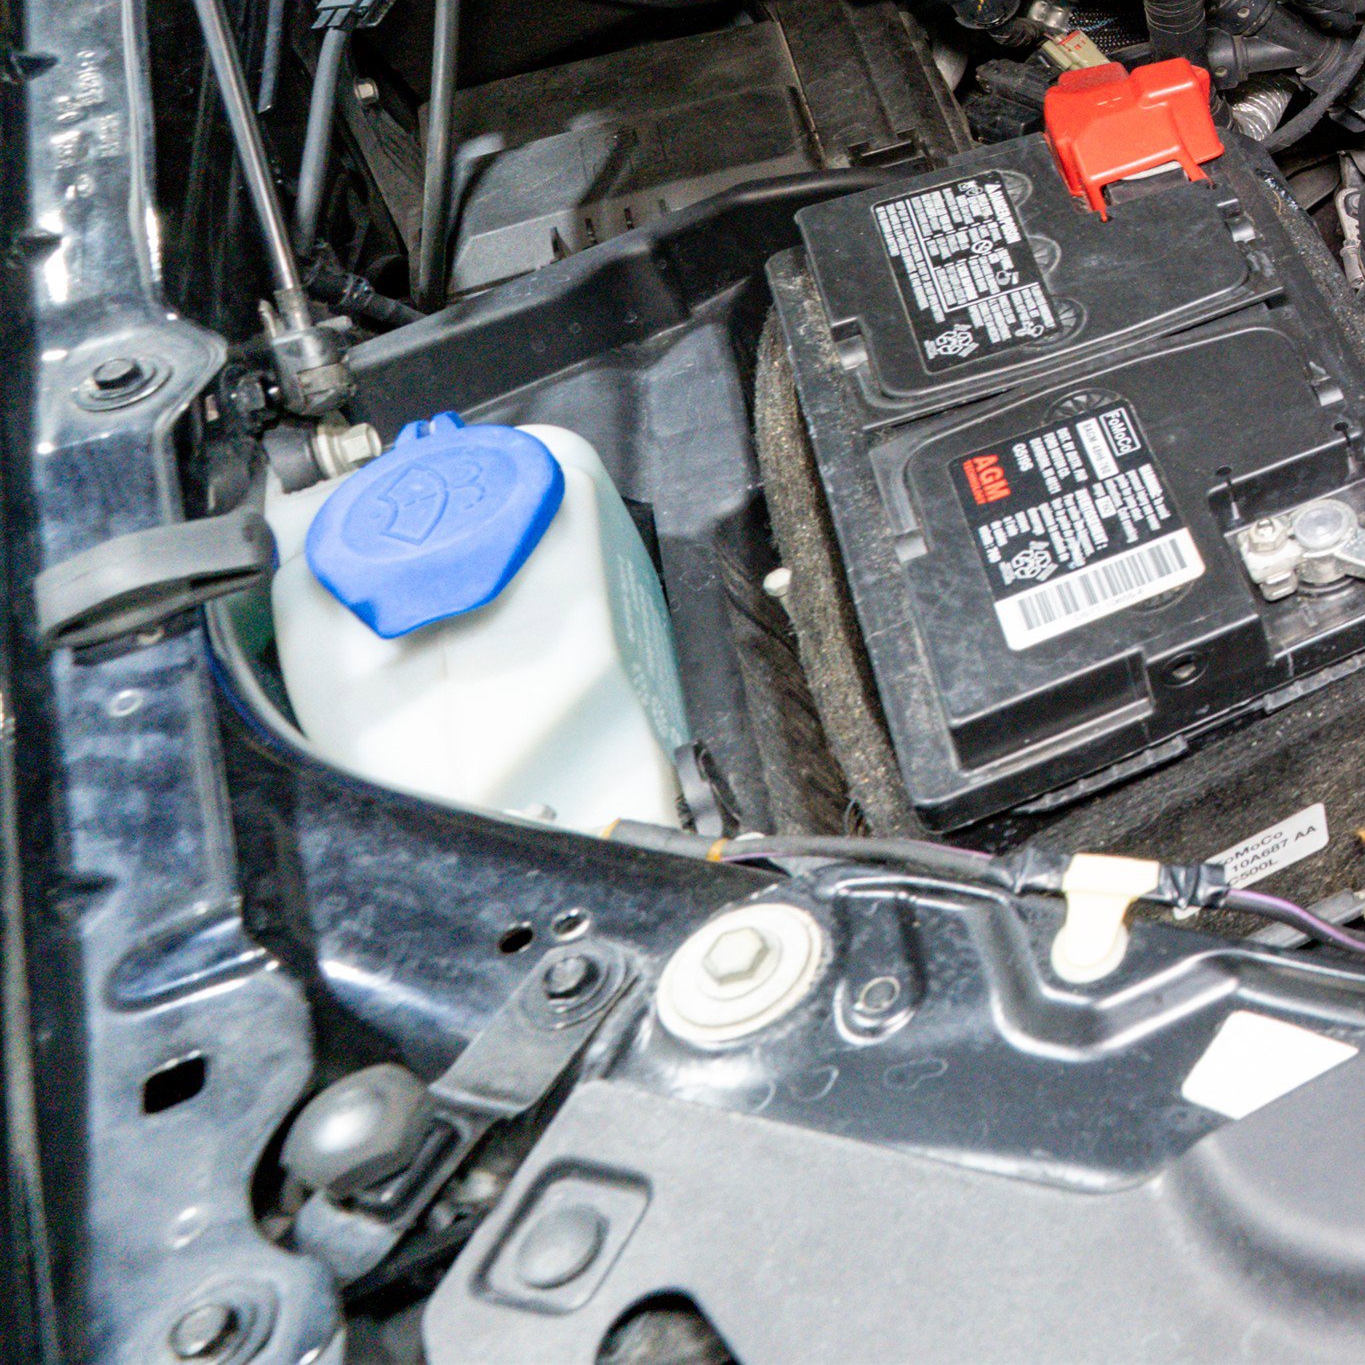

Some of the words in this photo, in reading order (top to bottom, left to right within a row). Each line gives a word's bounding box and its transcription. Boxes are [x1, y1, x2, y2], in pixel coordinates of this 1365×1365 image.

[1104, 410, 1133, 454] FoMoCo
[972, 454, 1011, 503] AGM
[1231, 838, 1289, 873] 10A687
[1294, 825, 1317, 842] AA
